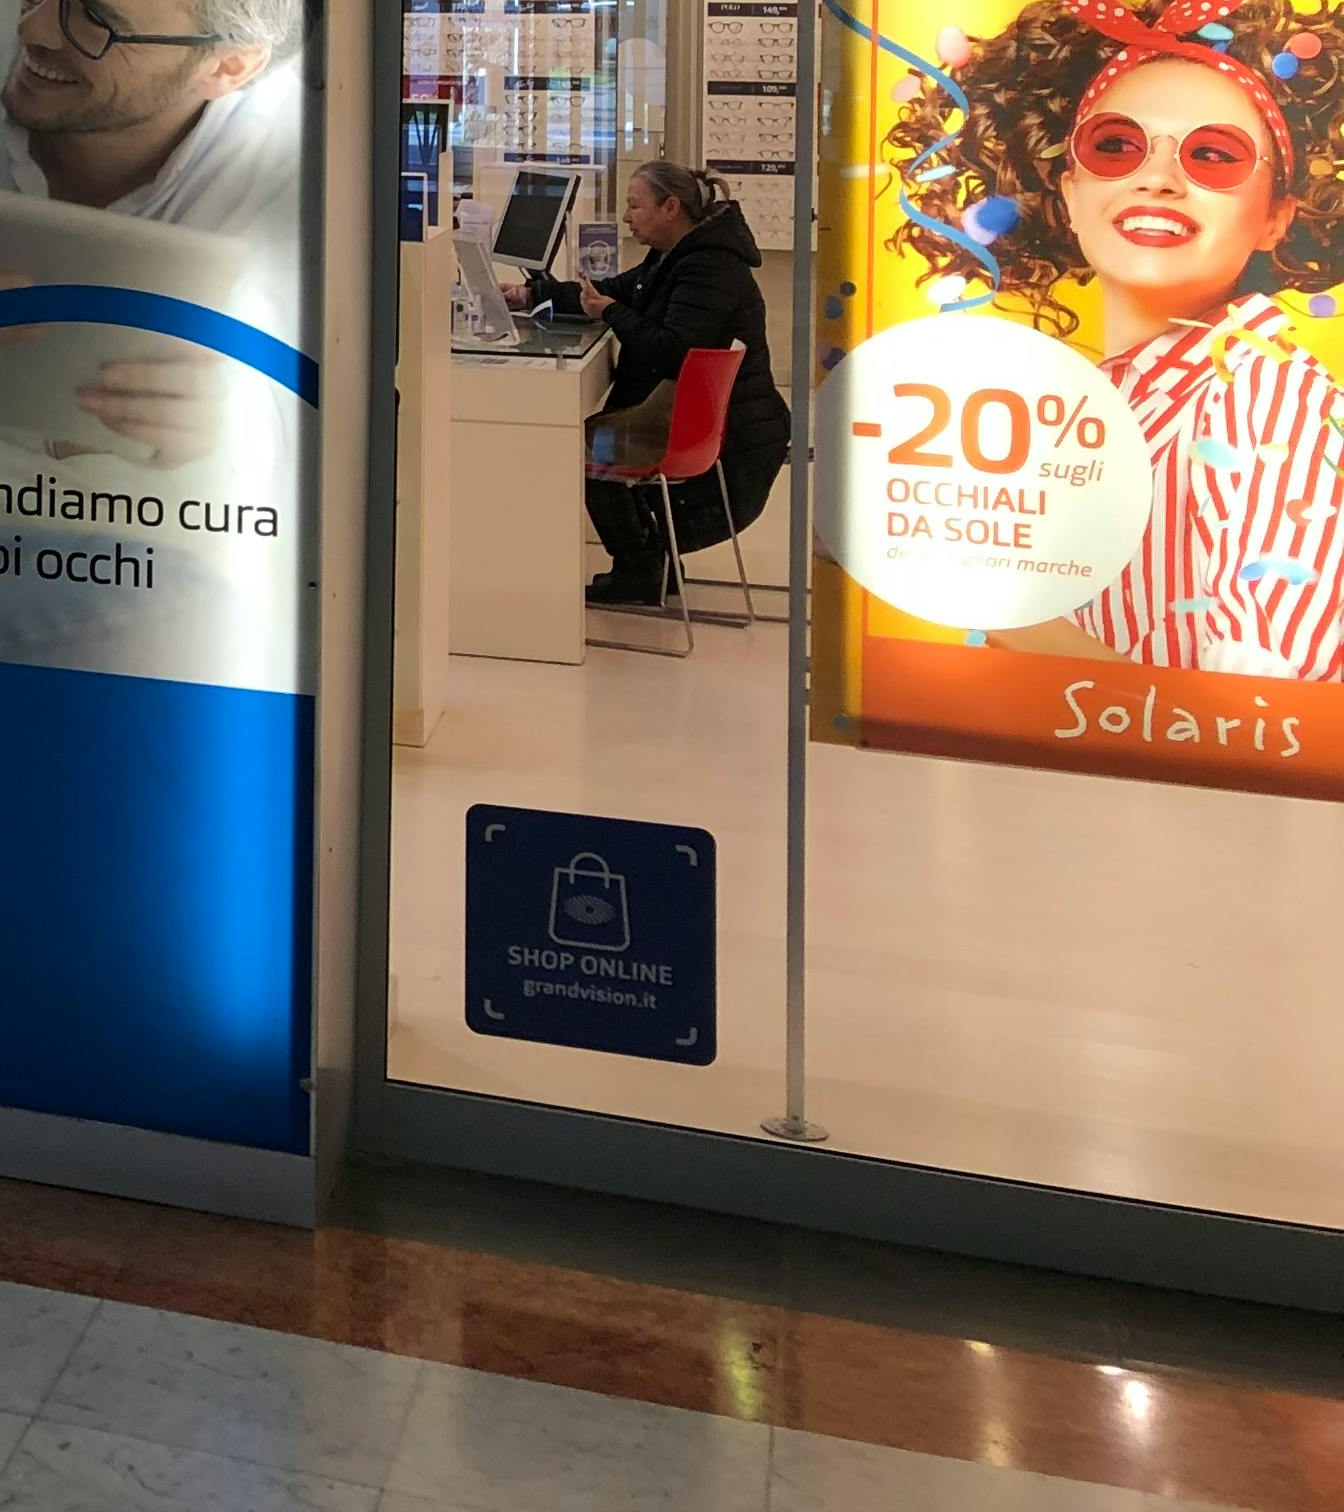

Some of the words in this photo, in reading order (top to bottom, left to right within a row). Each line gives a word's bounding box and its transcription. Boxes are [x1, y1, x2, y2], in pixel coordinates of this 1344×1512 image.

[851, 382, 1107, 475] -20%
[1038, 459, 1105, 487] sugli
[178, 496, 280, 537] cura
[886, 477, 1047, 516] OCCHIALI
[888, 511, 934, 540] DA
[944, 517, 1033, 550] SOLE
[35, 542, 155, 589] occhi
[1016, 558, 1093, 578] marche
[1053, 679, 1302, 758] Solaris
[507, 944, 575, 971] SHOP
[580, 954, 674, 986] ONLINE
[523, 978, 658, 1010] grandvision.it
